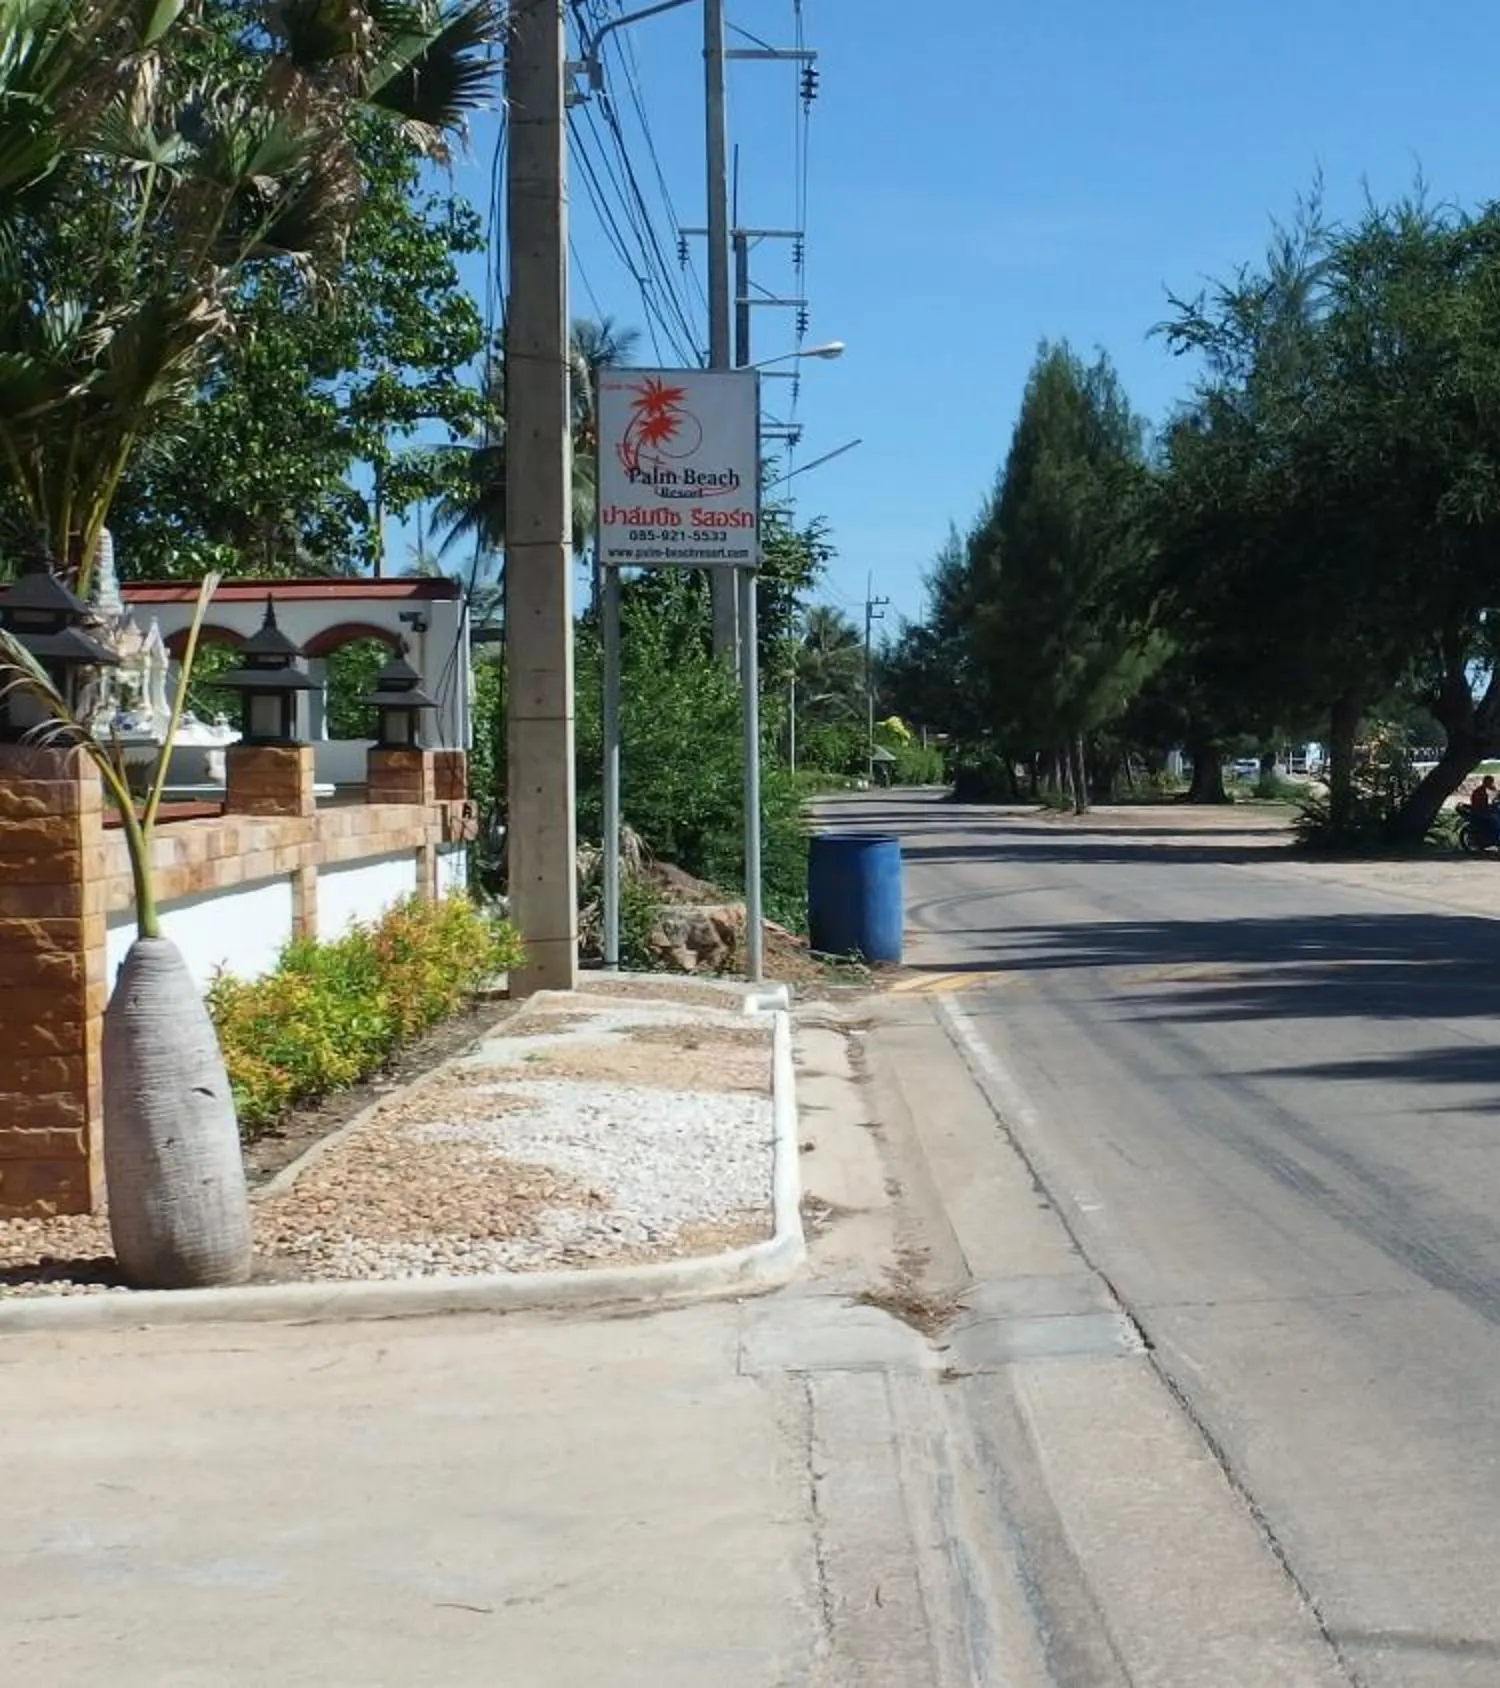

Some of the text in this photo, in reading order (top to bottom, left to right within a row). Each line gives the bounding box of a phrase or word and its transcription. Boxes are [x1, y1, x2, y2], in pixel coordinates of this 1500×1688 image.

[629, 466, 740, 487] Palm Beach
[661, 487, 704, 498] Resort
